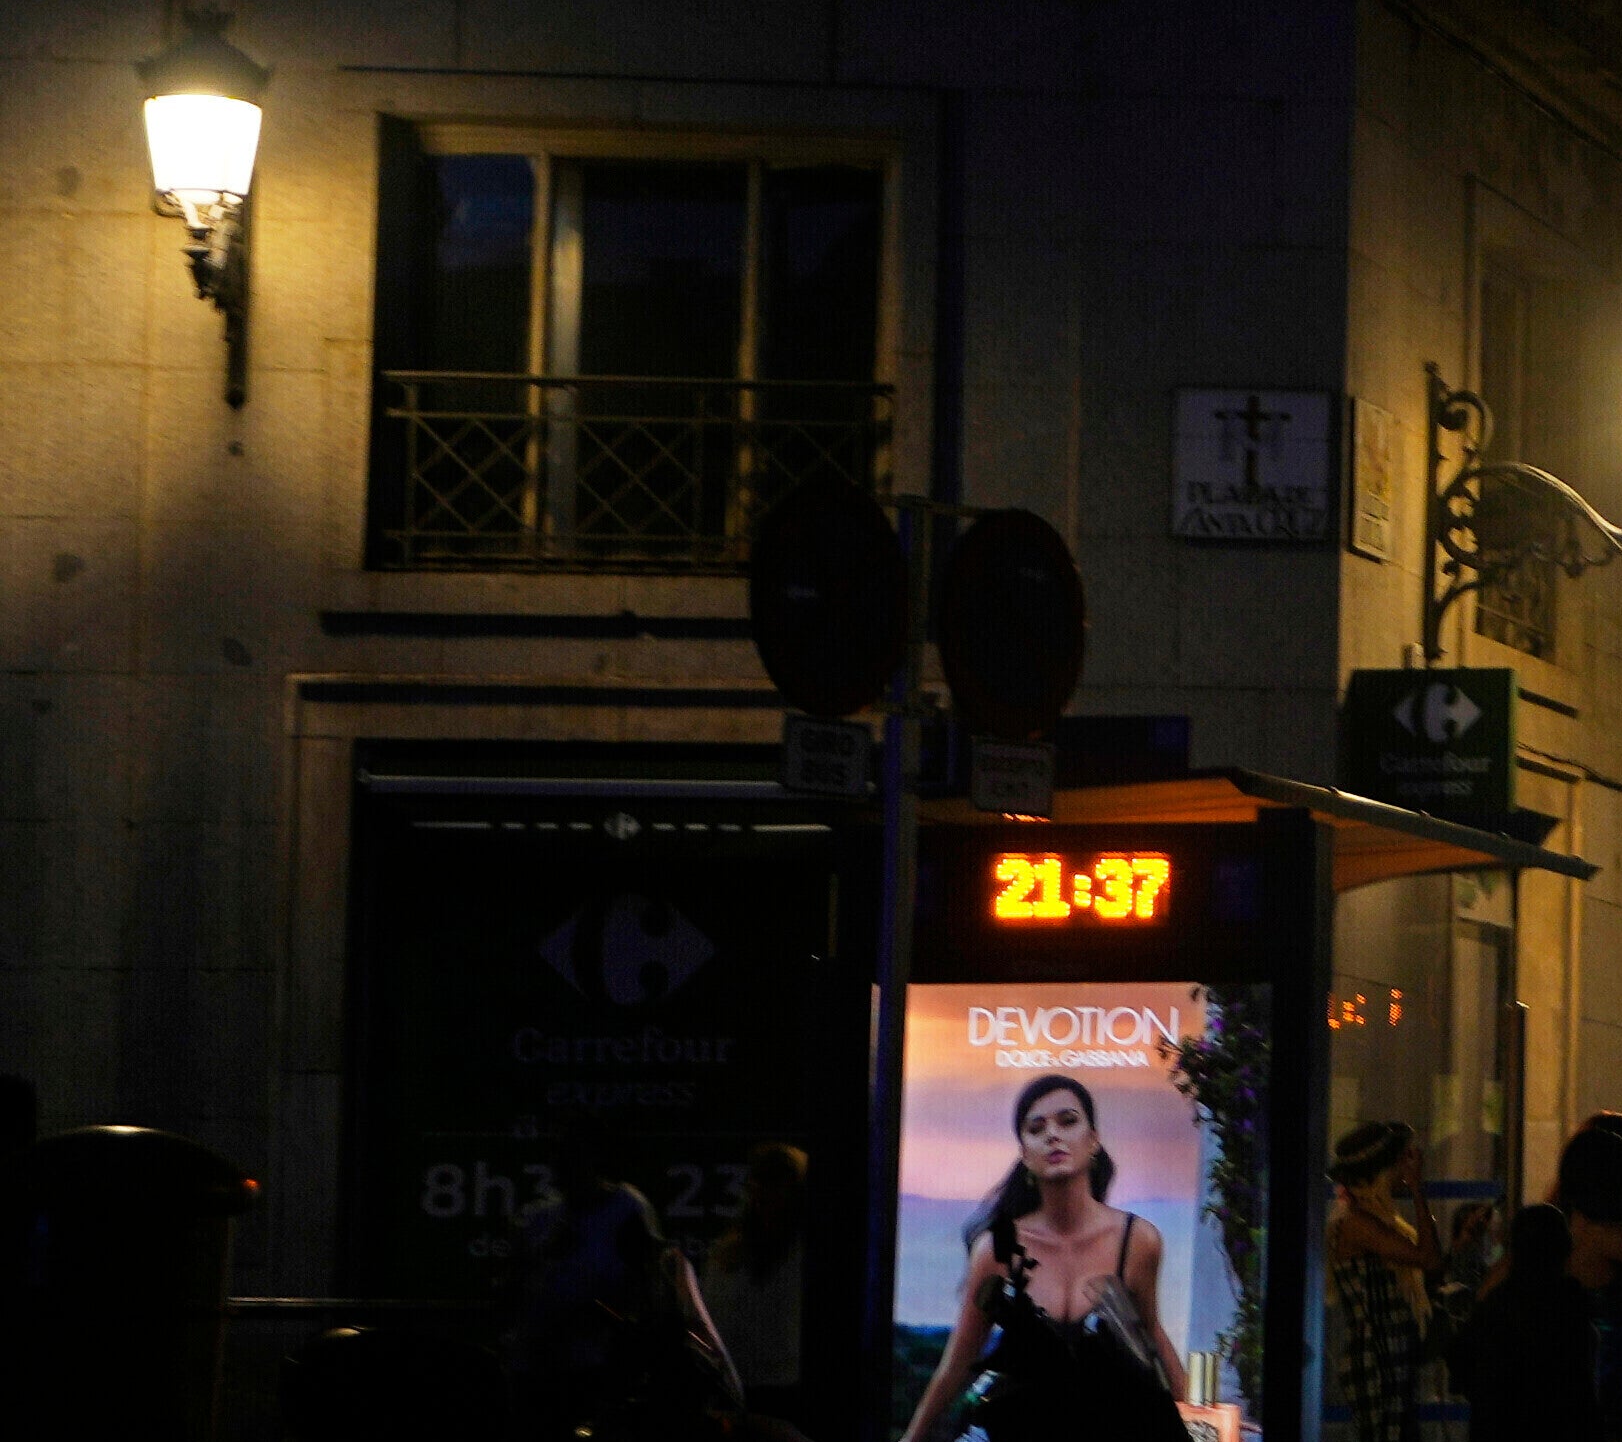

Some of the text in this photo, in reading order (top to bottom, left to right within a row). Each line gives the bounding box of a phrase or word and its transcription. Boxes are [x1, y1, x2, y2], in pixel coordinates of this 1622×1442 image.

[995, 852, 1170, 918] 21:37
[511, 1024, 737, 1064] Carrefour
[967, 1006, 1180, 1047] DEVOTION
